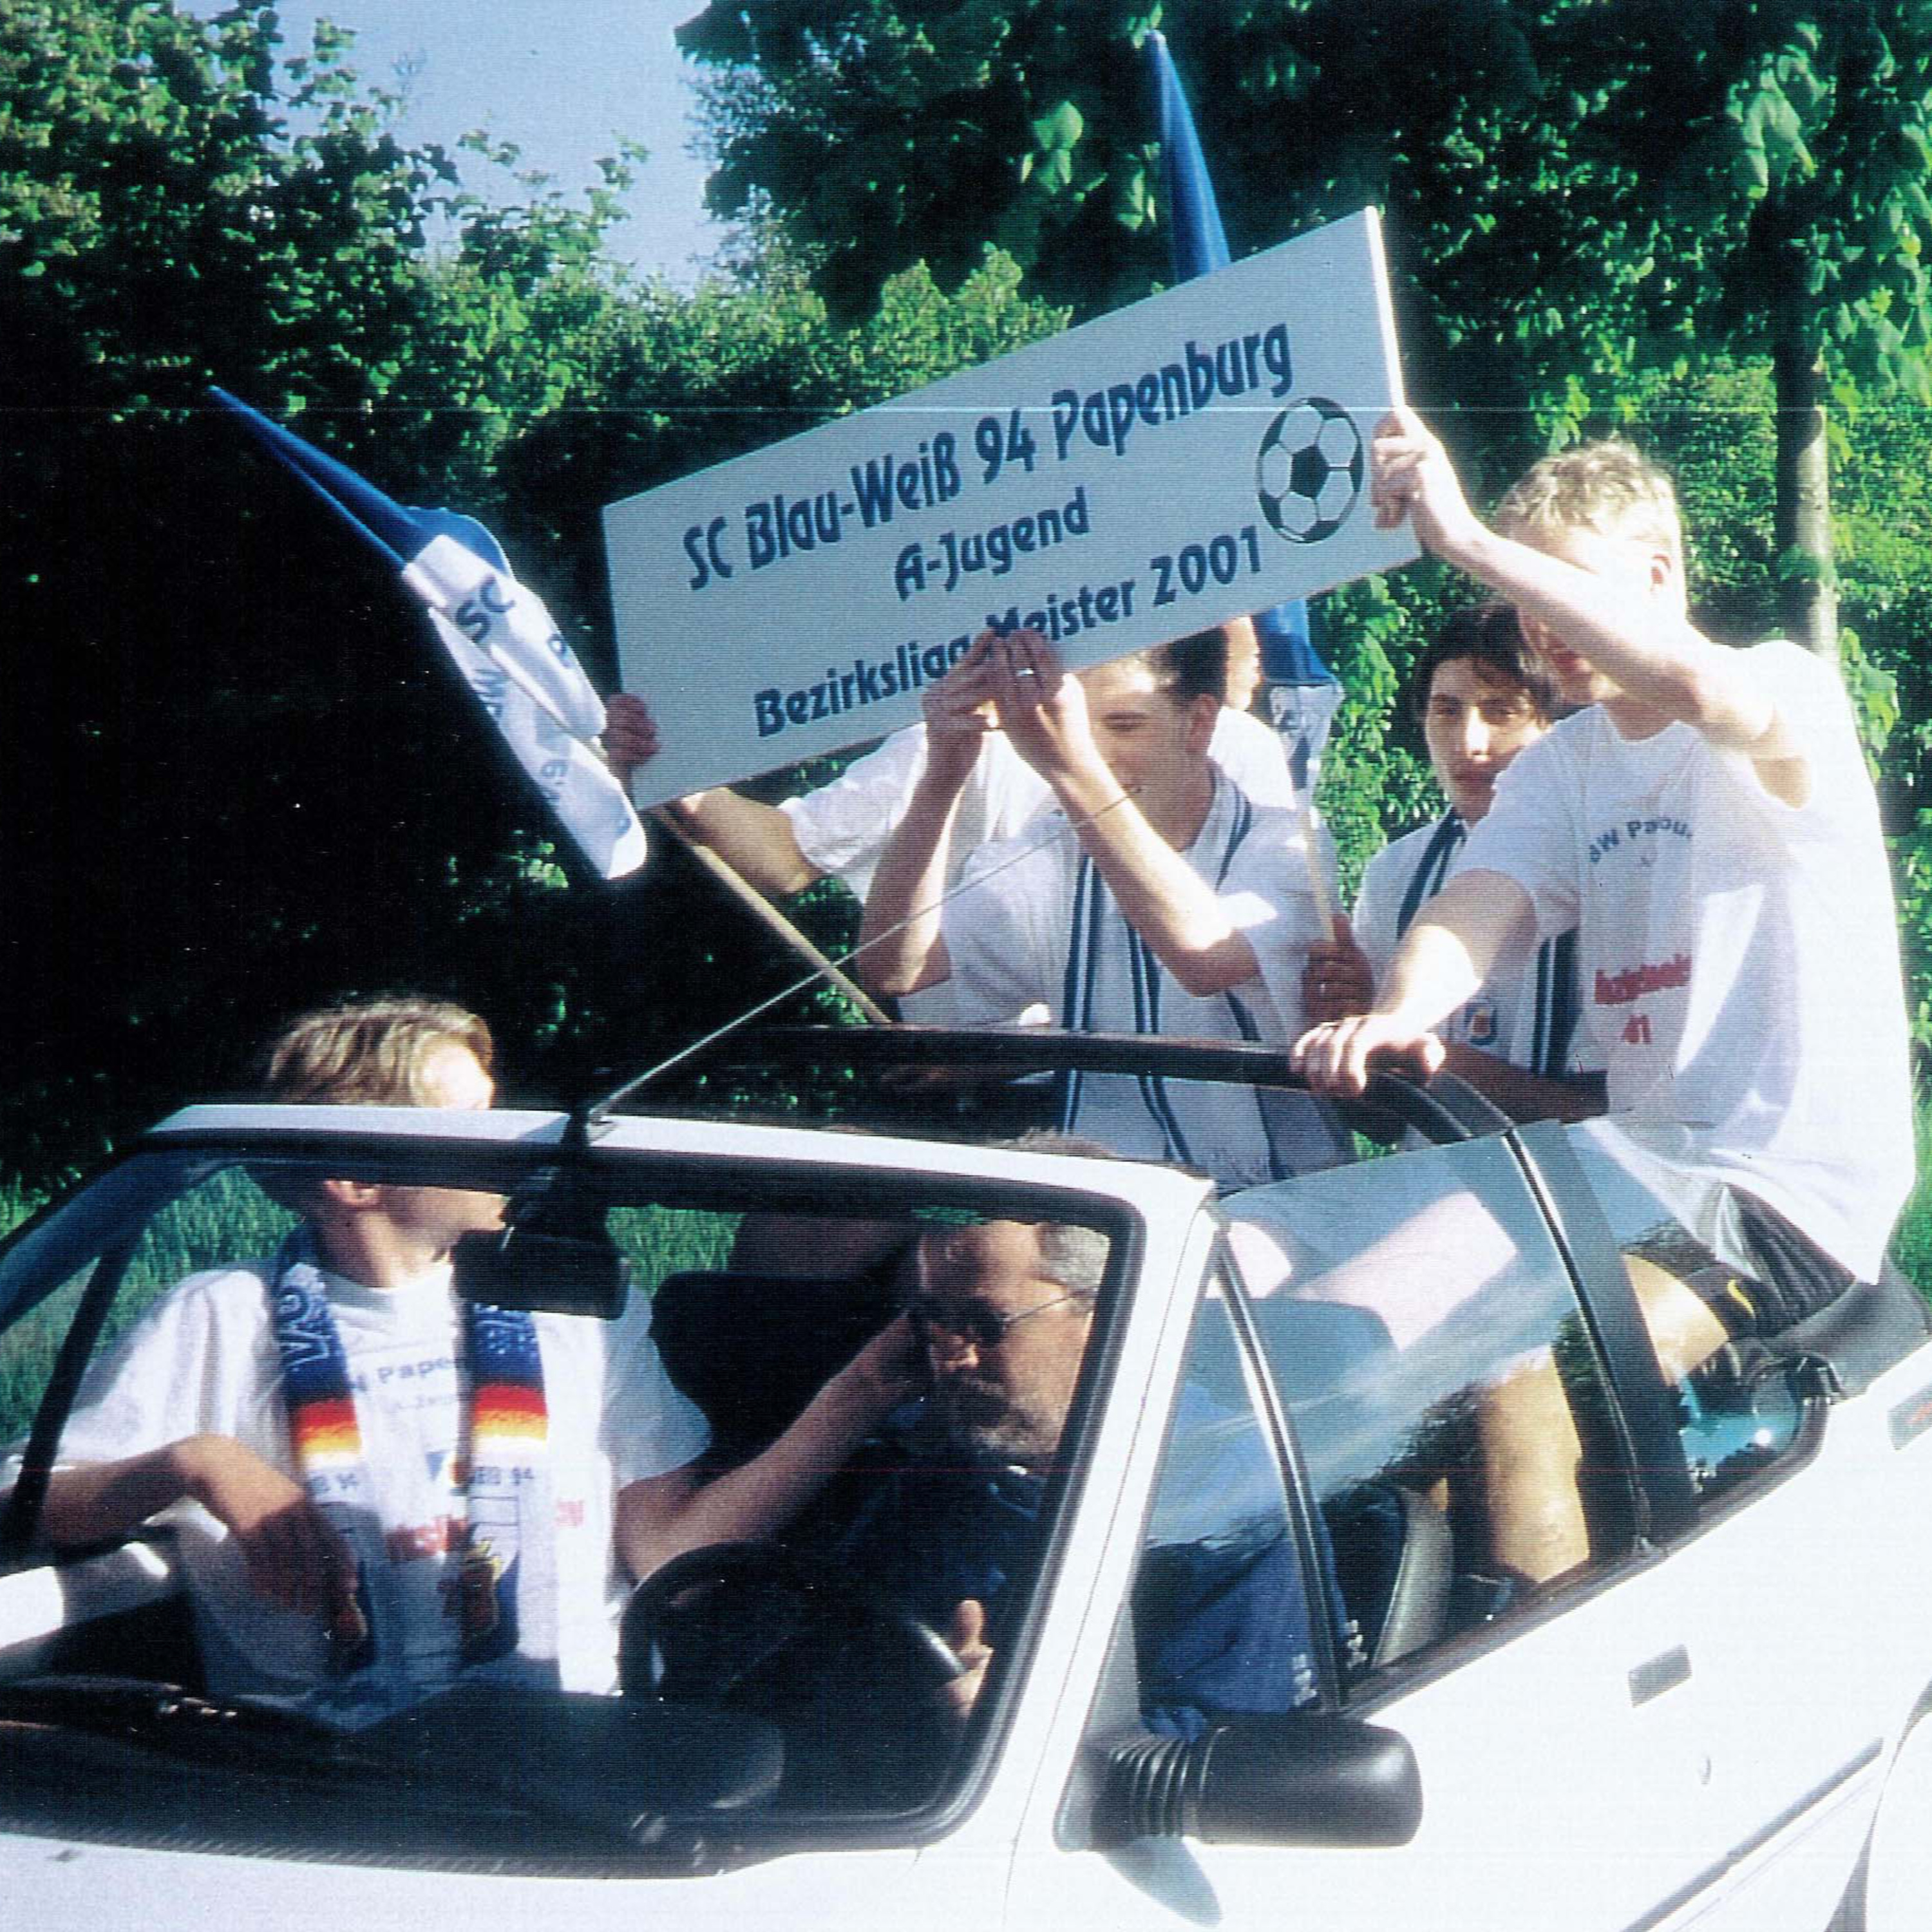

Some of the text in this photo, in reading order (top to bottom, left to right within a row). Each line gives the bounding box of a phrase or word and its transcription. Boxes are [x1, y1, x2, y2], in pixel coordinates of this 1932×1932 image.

[683, 323, 1293, 591] SC Blau-Weiß 94 Papenburg
[895, 487, 1090, 600] A-Jugend
[1151, 524, 1262, 607] 2001
[455, 573, 515, 643] SC
